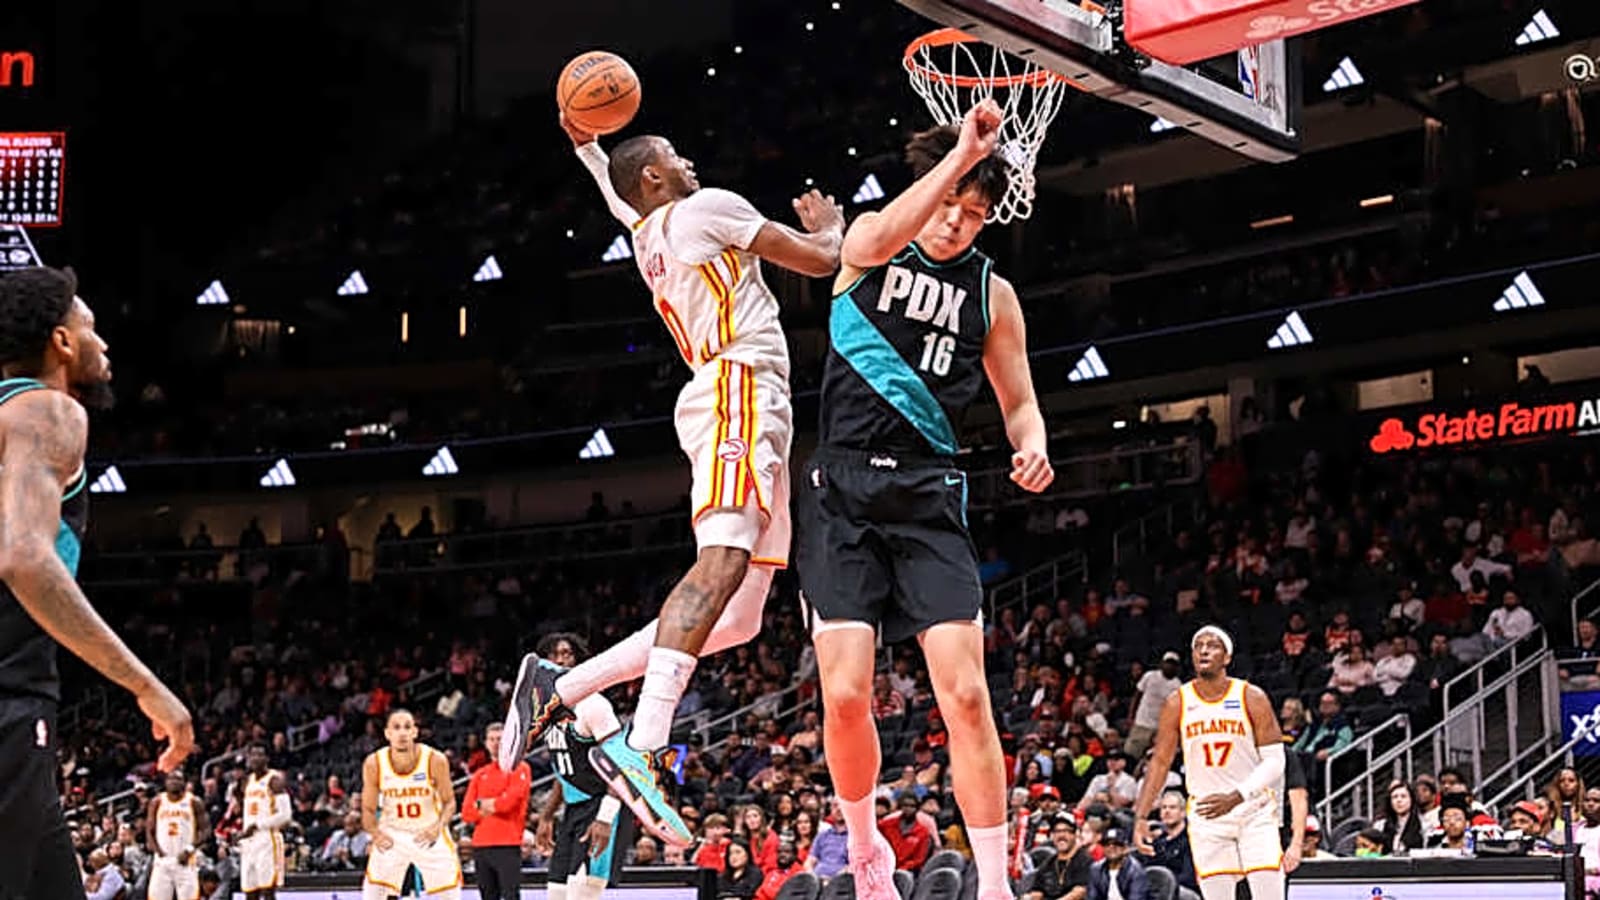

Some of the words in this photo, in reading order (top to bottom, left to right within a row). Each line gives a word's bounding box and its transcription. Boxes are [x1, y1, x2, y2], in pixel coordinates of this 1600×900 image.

[877, 264, 968, 334] PDX
[659, 297, 693, 363] 0
[919, 332, 956, 376] 16
[1417, 410, 1495, 446] State
[1498, 402, 1576, 436] Farm
[1186, 718, 1246, 738] ATLANTA
[556, 752, 574, 775] 11
[1202, 741, 1233, 767] 17
[383, 787, 430, 798] ATLANTA
[397, 803, 421, 818] 10
